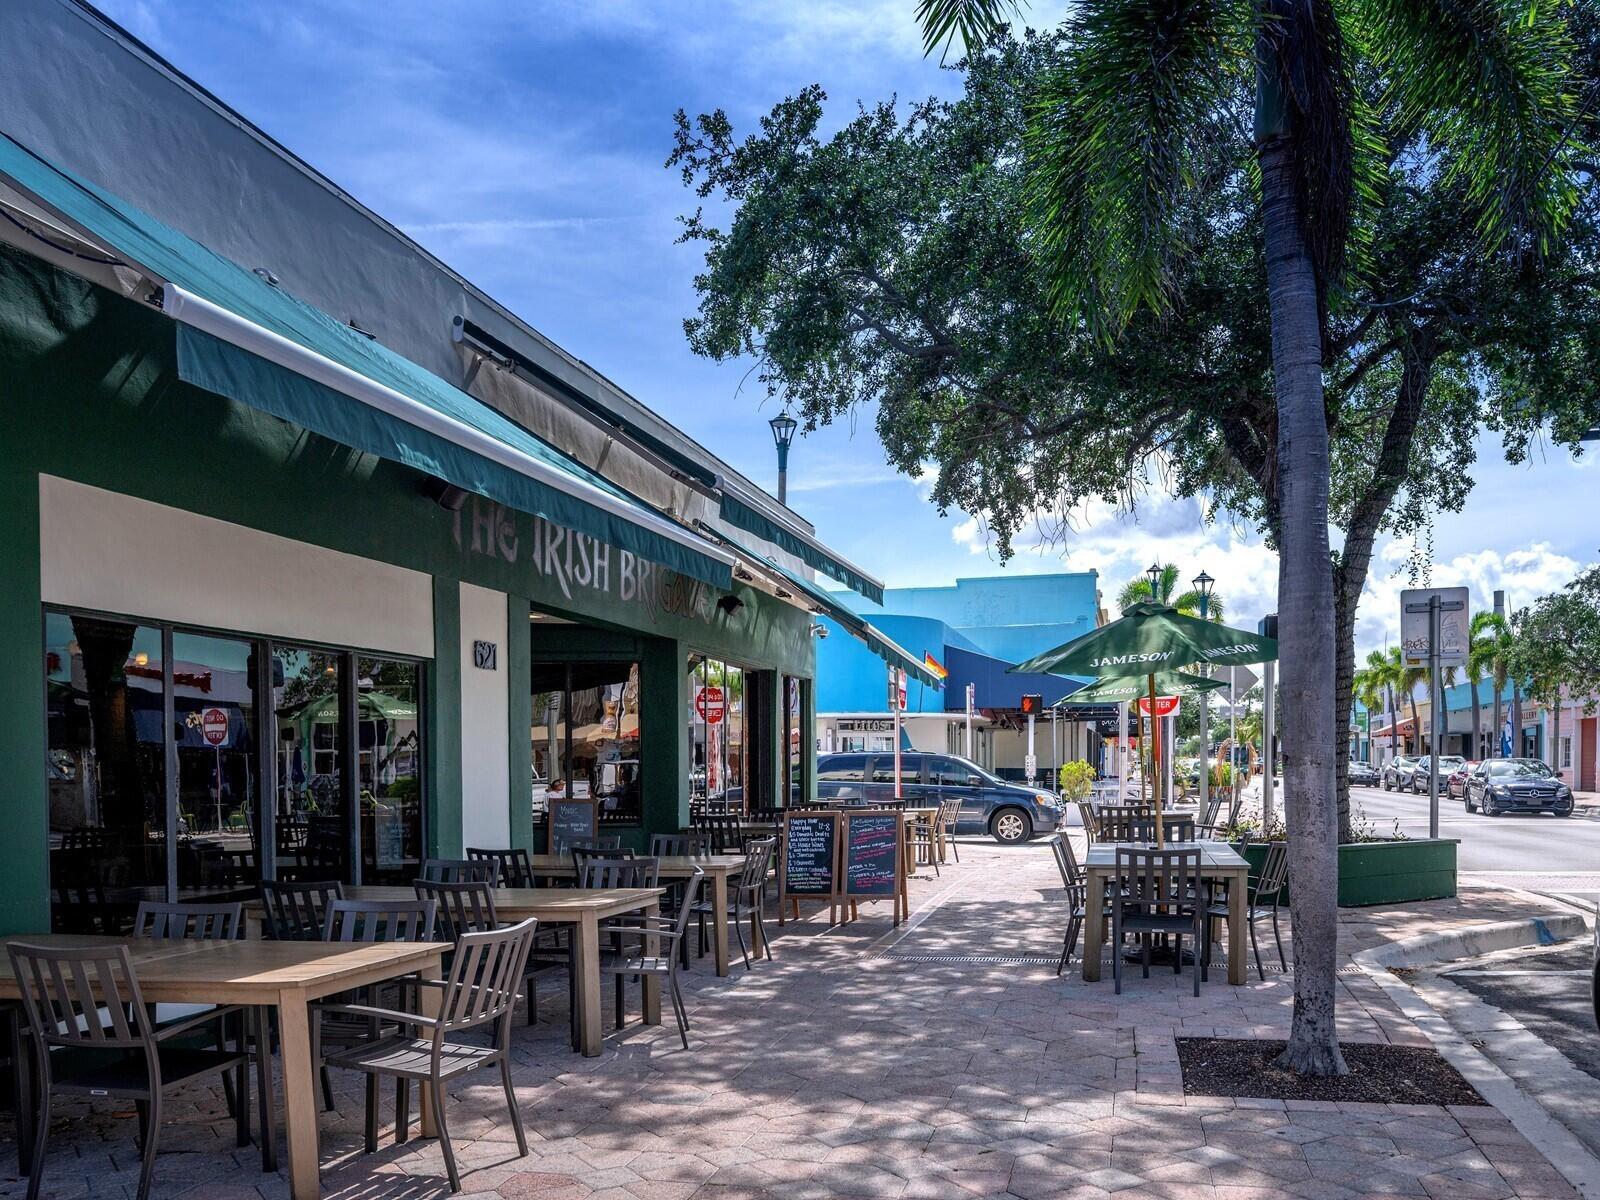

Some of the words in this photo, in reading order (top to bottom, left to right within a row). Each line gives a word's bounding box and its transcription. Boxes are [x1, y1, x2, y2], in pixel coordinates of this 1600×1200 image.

[533, 517, 609, 600] IRISH
[474, 640, 497, 670] 621
[1089, 651, 1172, 667] JAMESON
[1091, 687, 1138, 698] JAMESON
[1146, 701, 1171, 709] ETER
